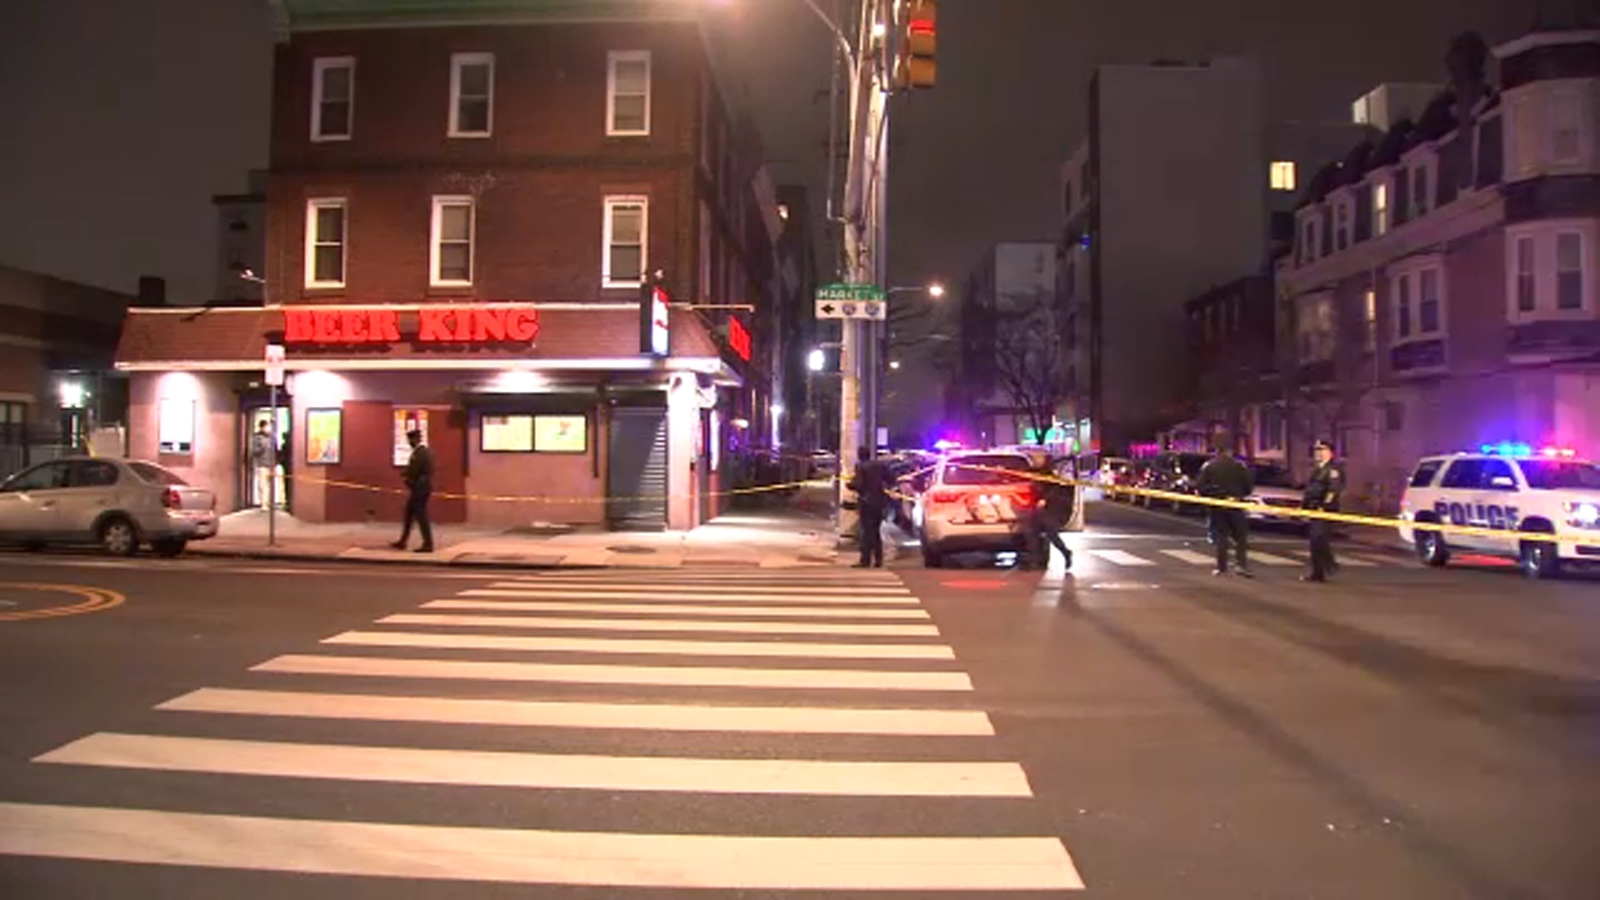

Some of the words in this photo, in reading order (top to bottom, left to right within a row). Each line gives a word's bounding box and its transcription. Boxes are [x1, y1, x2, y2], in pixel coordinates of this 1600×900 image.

[818, 289, 870, 300] MARKET
[285, 309, 400, 342] BEER
[418, 308, 538, 342] KING
[1434, 501, 1520, 532] POLICE
